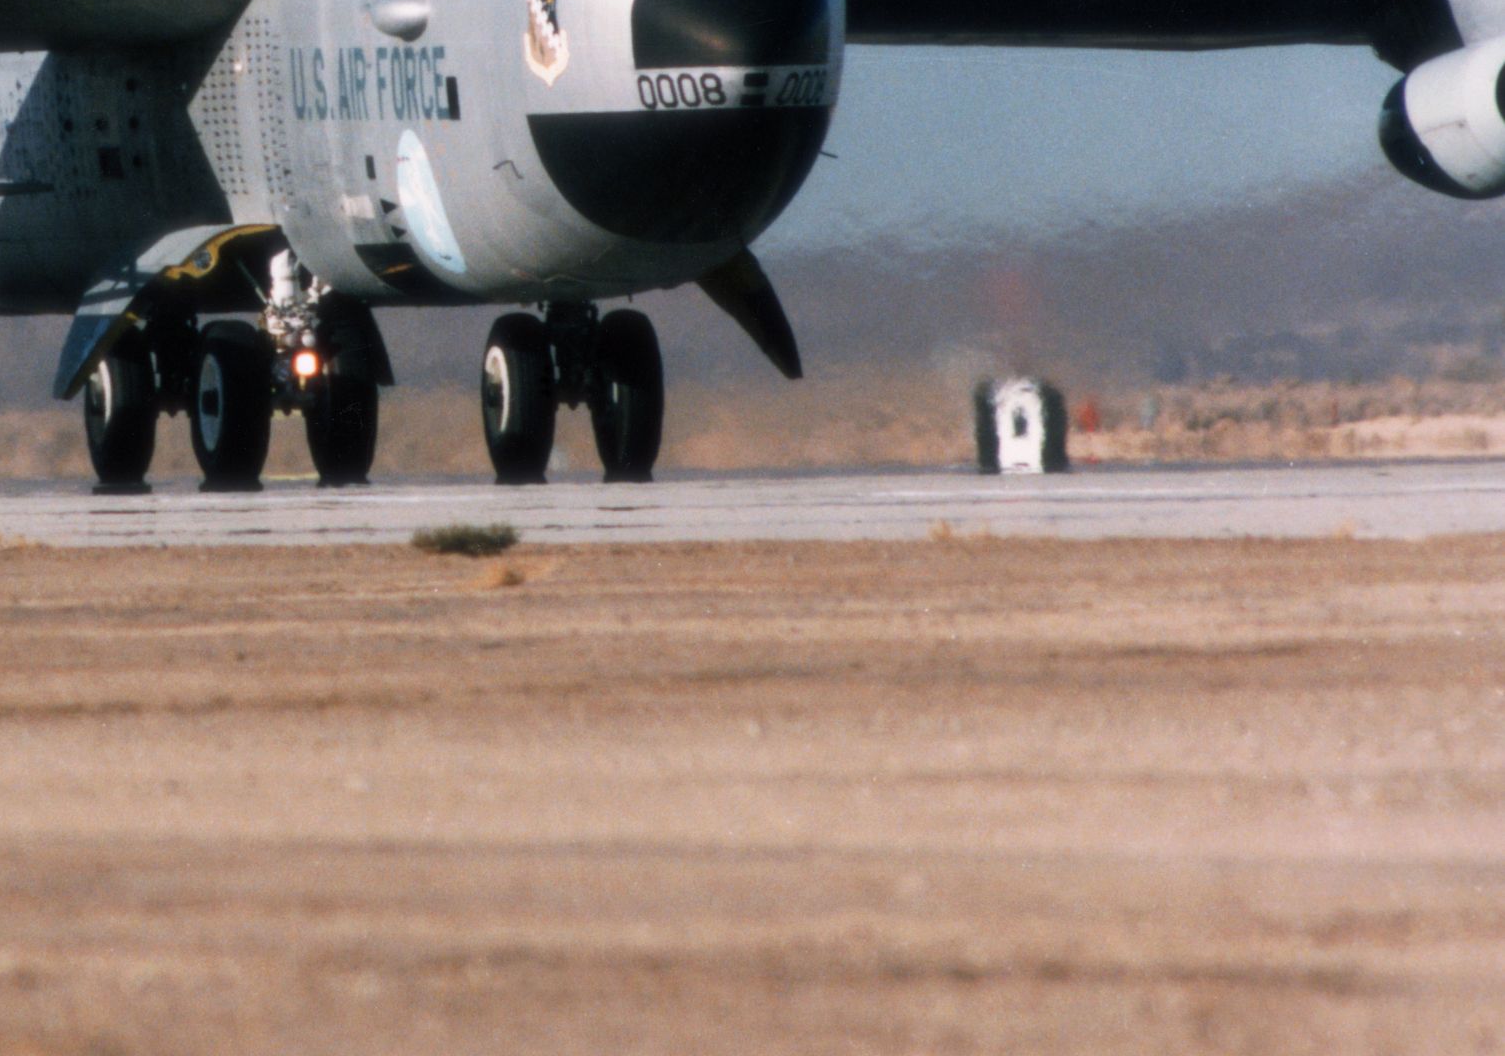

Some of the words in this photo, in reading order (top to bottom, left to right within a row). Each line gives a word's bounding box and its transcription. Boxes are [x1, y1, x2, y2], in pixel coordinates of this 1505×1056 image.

[290, 47, 335, 121] U.S.
[338, 47, 368, 121] AIR
[376, 46, 451, 121] FORCE
[637, 72, 727, 110] 0008
